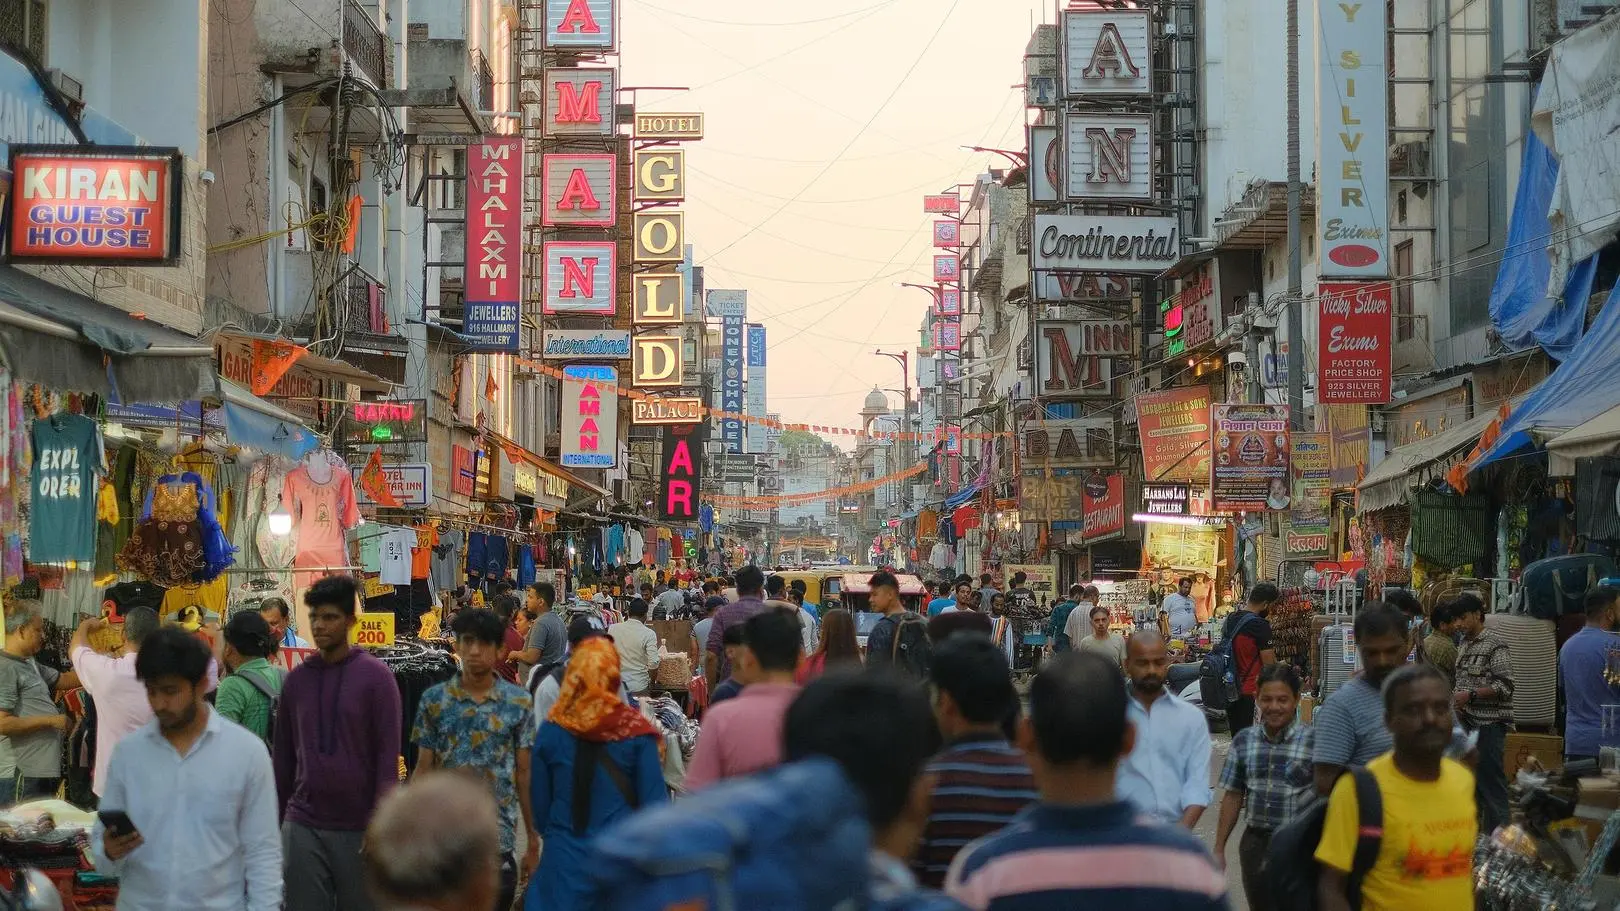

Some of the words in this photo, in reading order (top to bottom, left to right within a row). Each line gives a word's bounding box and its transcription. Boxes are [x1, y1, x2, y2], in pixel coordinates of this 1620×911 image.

[639, 117, 699, 133] HOTEL
[1338, 50, 1364, 208] SILVER
[23, 166, 158, 202] KIRAN
[28, 204, 151, 226] GUEST
[479, 144, 510, 296] MAHALAXMI
[27, 226, 152, 249] HOUSE
[1039, 225, 1177, 261] Continental
[639, 156, 678, 381] GOLD
[469, 305, 517, 321] JEWELLERS
[1321, 289, 1351, 320] Vicky
[1355, 288, 1388, 315] Silver
[468, 323, 481, 333] 916
[481, 323, 516, 333] HALLMARK
[1083, 324, 1130, 352] INN
[544, 333, 630, 355] International
[726, 317, 741, 366] MONEY
[1325, 369, 1354, 377] PRICE
[1356, 369, 1382, 377] SHOP
[1331, 359, 1376, 368] FACTORY
[1325, 390, 1382, 399] JEWELLERY
[1347, 382, 1380, 390] SILVER
[579, 383, 601, 451] AMAN
[637, 402, 697, 419] PALACE
[1220, 420, 1257, 431] निशान
[1258, 420, 1285, 431] यात्रा
[1025, 427, 1113, 459] BAR
[40, 449, 80, 471] EXPL
[562, 453, 614, 466] INTERNATIONAL
[406, 482, 423, 491] INN
[1144, 487, 1173, 500] HARBANS
[1174, 486, 1186, 500] LAL
[1147, 500, 1183, 513] JEWELLERS
[1083, 503, 1122, 533] RESTAURANT
[1287, 530, 1328, 552] दिलबाग
[361, 621, 382, 630] SALE
[357, 631, 386, 643] 200
